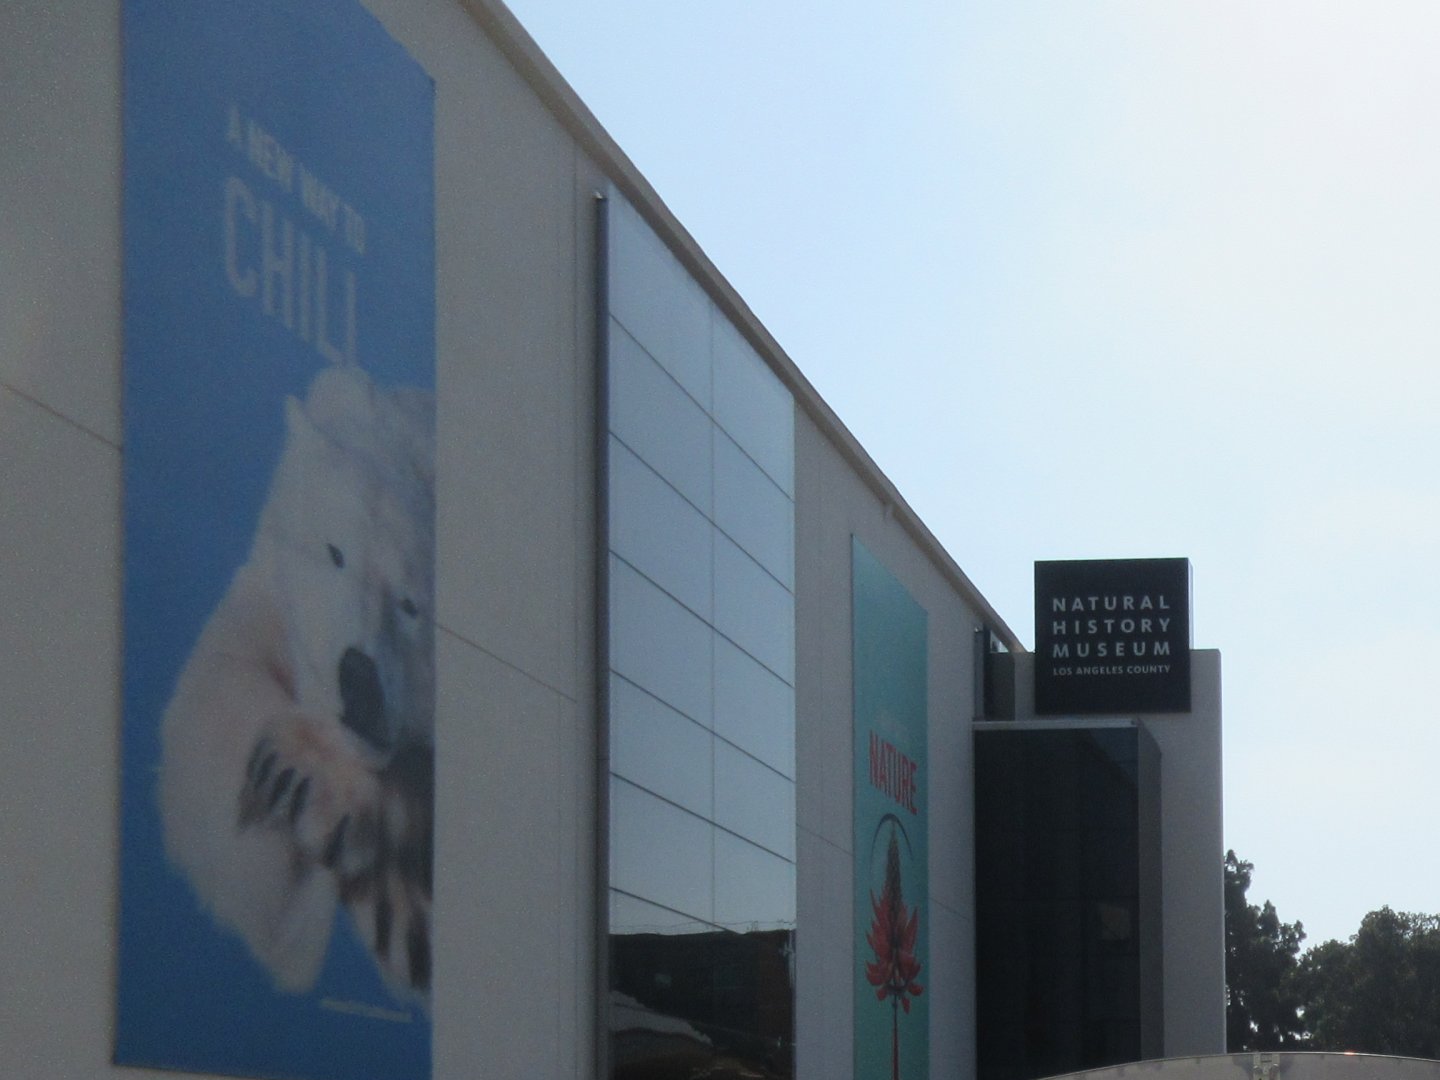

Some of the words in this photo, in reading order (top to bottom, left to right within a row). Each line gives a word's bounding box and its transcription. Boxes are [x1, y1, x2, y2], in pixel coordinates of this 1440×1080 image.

[1052, 595, 1171, 612] NATURAL
[1052, 617, 1171, 635] HISTORY
[1052, 641, 1171, 658] MUSEUM
[1053, 666, 1073, 676] LOS
[1076, 666, 1124, 675] ANGELES
[1127, 665, 1170, 674] COUNTY
[869, 729, 917, 815] NATURE
